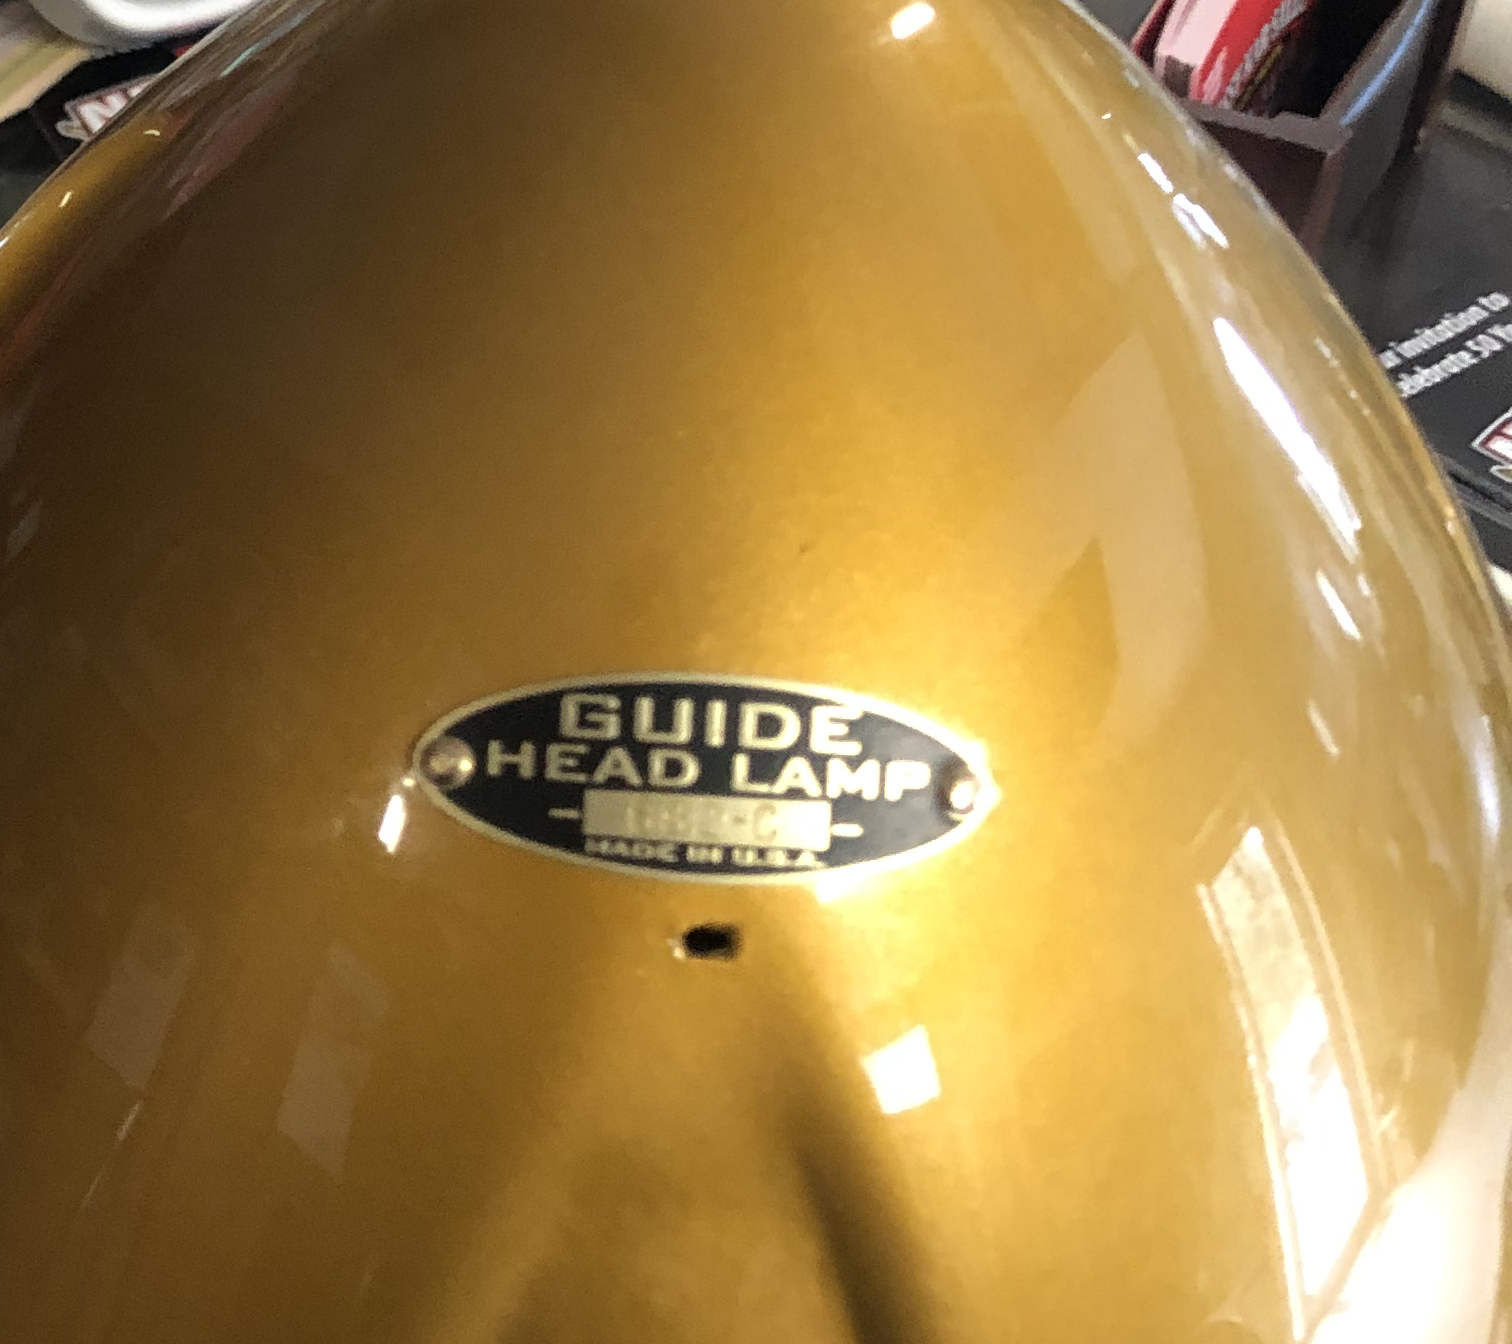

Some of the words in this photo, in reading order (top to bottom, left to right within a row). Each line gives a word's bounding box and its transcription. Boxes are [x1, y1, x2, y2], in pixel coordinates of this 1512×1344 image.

[1388, 305, 1489, 359] invitation
[1476, 291, 1510, 312] to
[1396, 350, 1480, 398] elebrate
[1464, 334, 1503, 359] 50
[558, 692, 866, 757] GUIDE
[486, 737, 702, 788] HEAD
[727, 751, 933, 802] LAMP
[686, 845, 723, 865] IN
